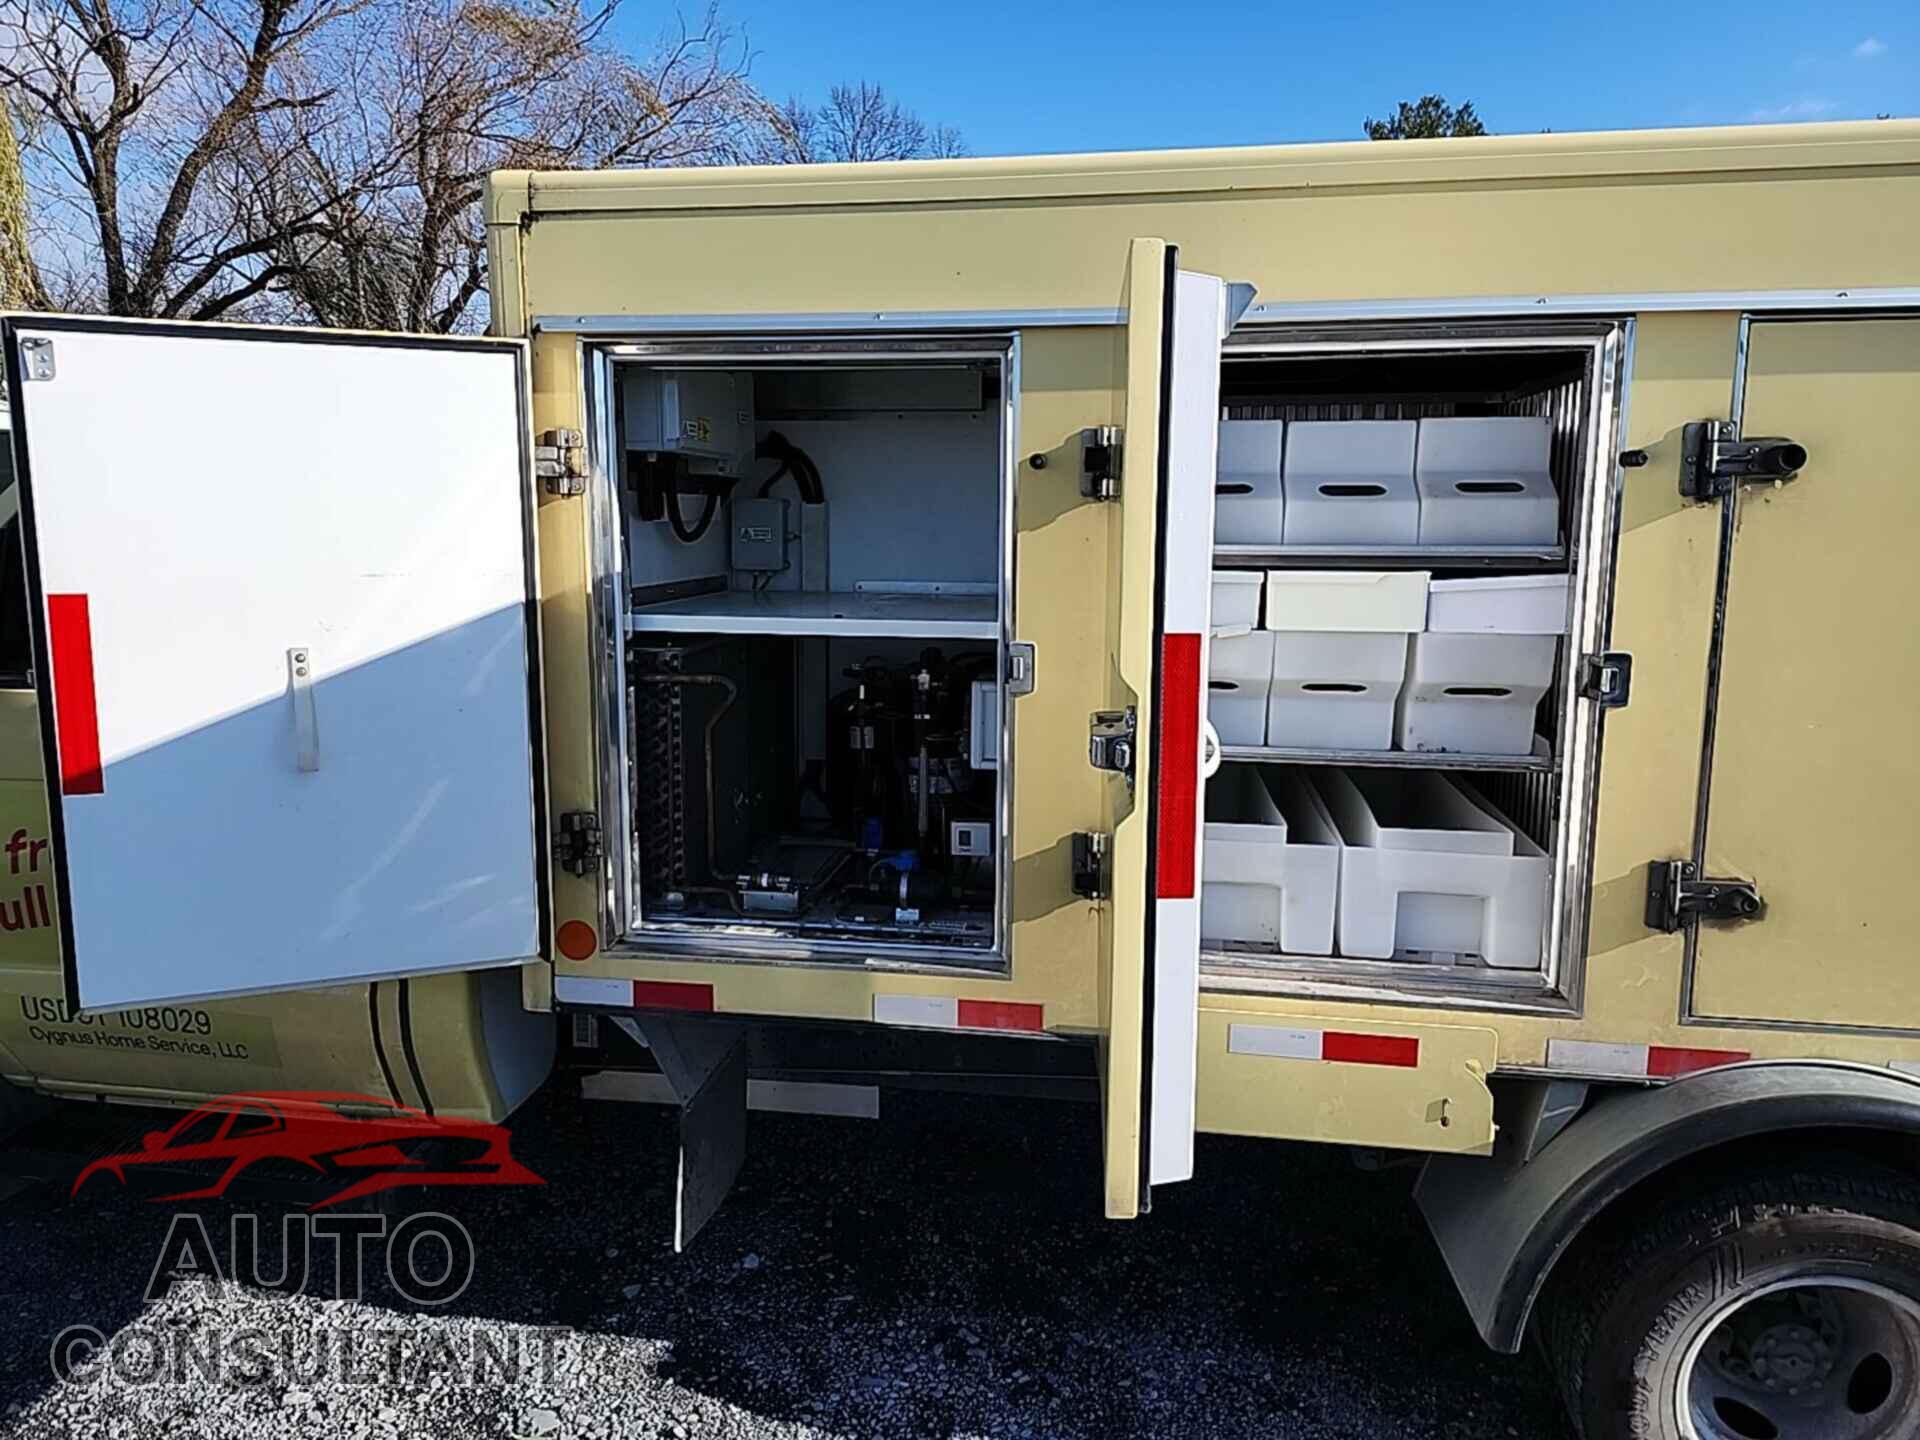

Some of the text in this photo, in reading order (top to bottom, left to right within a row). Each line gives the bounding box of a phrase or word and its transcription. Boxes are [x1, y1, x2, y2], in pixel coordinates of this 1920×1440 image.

[5, 829, 52, 874] fr
[29, 1025, 249, 1060] Cygnus Home Service, LLC
